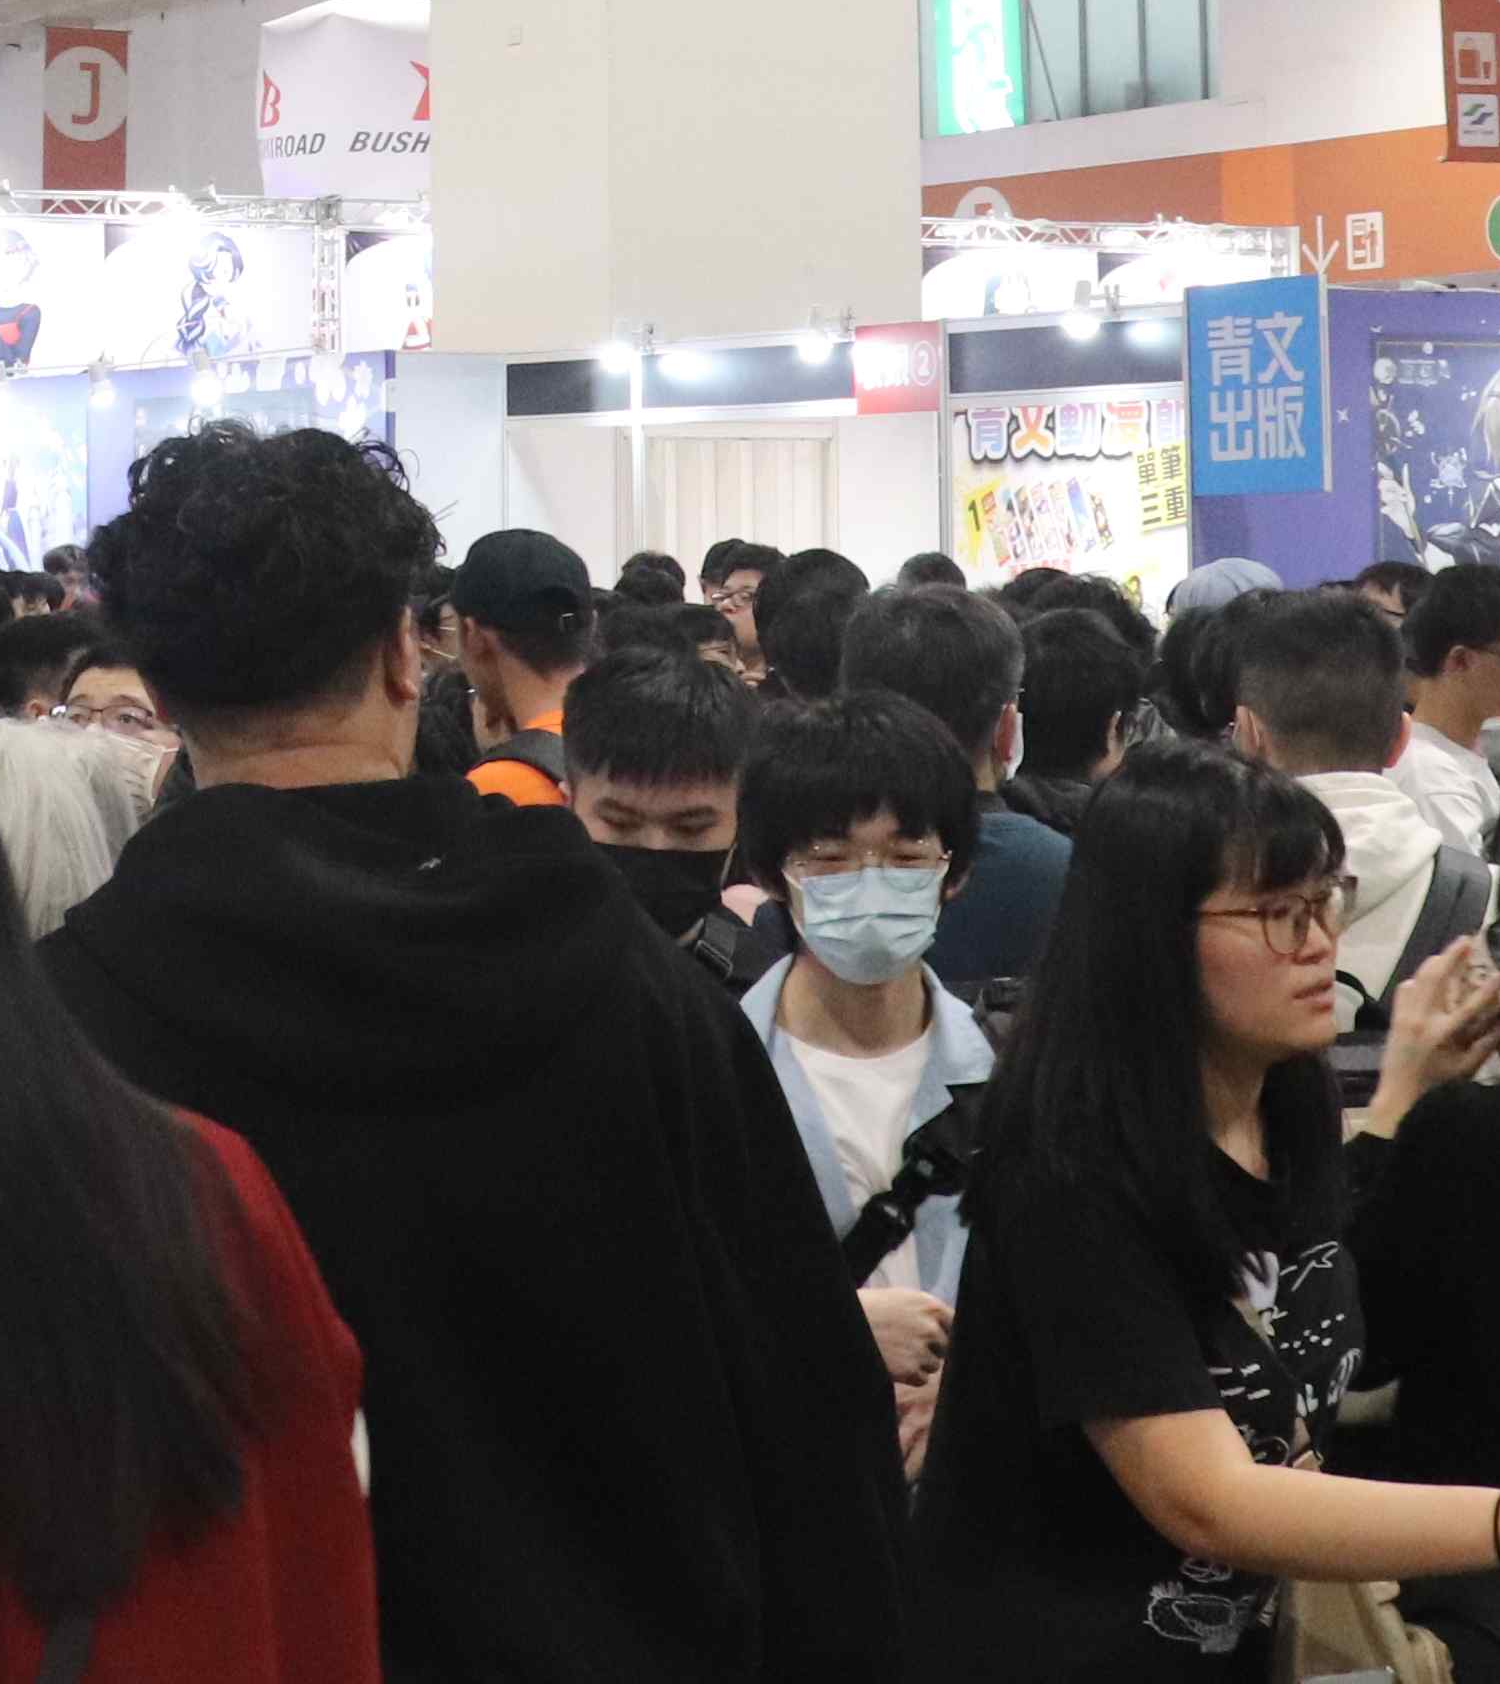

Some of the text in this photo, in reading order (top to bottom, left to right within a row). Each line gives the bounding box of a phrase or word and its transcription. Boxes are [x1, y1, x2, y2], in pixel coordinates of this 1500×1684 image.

[71, 62, 100, 125] J
[1206, 312, 1305, 386] 青文
[1207, 390, 1306, 463] 出版
